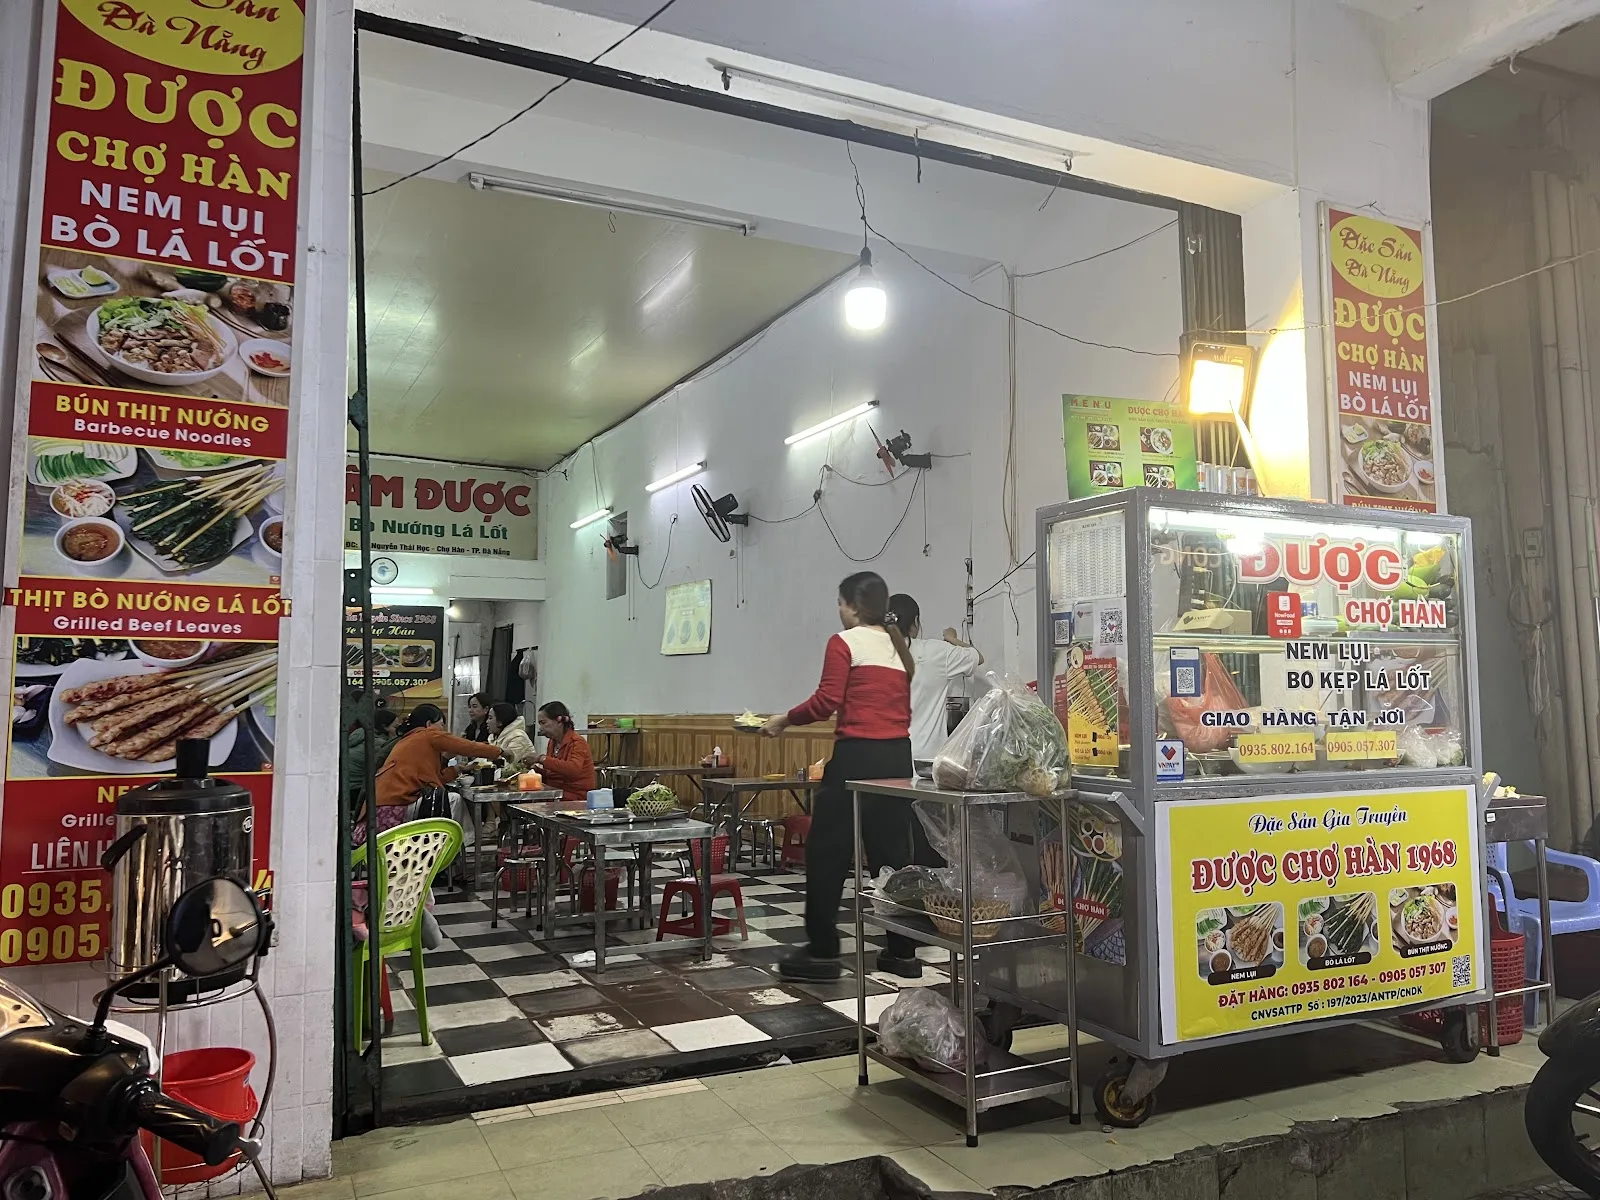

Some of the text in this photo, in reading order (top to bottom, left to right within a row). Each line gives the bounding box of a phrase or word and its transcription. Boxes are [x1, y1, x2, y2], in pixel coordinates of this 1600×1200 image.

[97, 1, 157, 36] Đà
[54, 58, 298, 149] ĐƯỢC
[56, 130, 291, 201] CHỢ HÀN
[80, 179, 264, 239] NEM LỤI
[51, 214, 289, 276] BÒ LÁ LỐT
[1338, 226, 1413, 262] Đặc Sản
[1345, 258, 1369, 278] Đà
[1334, 297, 1425, 345] ĐƯỢC
[1337, 341, 1425, 374] CHỢ HÀN
[1348, 370, 1417, 399] NEM LỤI
[56, 393, 269, 432] BÚN THỊT NƯỚNG
[1340, 391, 1428, 420] BÒ LÁ LỐT
[74, 418, 252, 448] Barbecue Noodles
[414, 478, 532, 522] ĐƯỢC
[382, 519, 445, 537] Nướng
[452, 523, 473, 538] Lá
[479, 523, 508, 540] Lốt
[1239, 537, 1402, 591] ĐƯỢC
[10, 587, 292, 616] THỊT BÒ NƯỚNG LÁ LỐT
[1346, 595, 1445, 629] CHỢ HÀN
[53, 615, 242, 634] Grilled Beef Leaves
[1286, 642, 1369, 664] NEM LỤI
[347, 678, 363, 686] 164
[1320, 671, 1359, 693] KẸP
[1366, 668, 1389, 689] LÁ
[1397, 665, 1430, 689] LỐT
[1201, 711, 1251, 726] GIAO
[1262, 708, 1317, 726] HÀNG
[1327, 708, 1365, 729] TẬN
[1240, 739, 1396, 757] 0935.802.164 0905.057.307
[61, 813, 115, 828] Grille
[1249, 804, 1408, 835] Đặc Sản Gia Truyền
[31, 836, 89, 870] LIÊN
[1190, 836, 1457, 896] ĐƯỢC CHỢ HÀN 1968
[1218, 990, 1246, 1009] ĐẶT
[1249, 985, 1289, 1002] HÀNG:
[1291, 981, 1319, 996] 0935
[1323, 977, 1345, 991] 802
[1348, 975, 1368, 988] 164
[1379, 969, 1406, 984] 0905
[1409, 965, 1426, 979] 057
[1429, 961, 1447, 975] 307
[1231, 972, 1245, 981] NEM
[1251, 1004, 1303, 1021] CNVSATTP
[1327, 985, 1423, 1009] 197/2023/ANTP/CNDK
